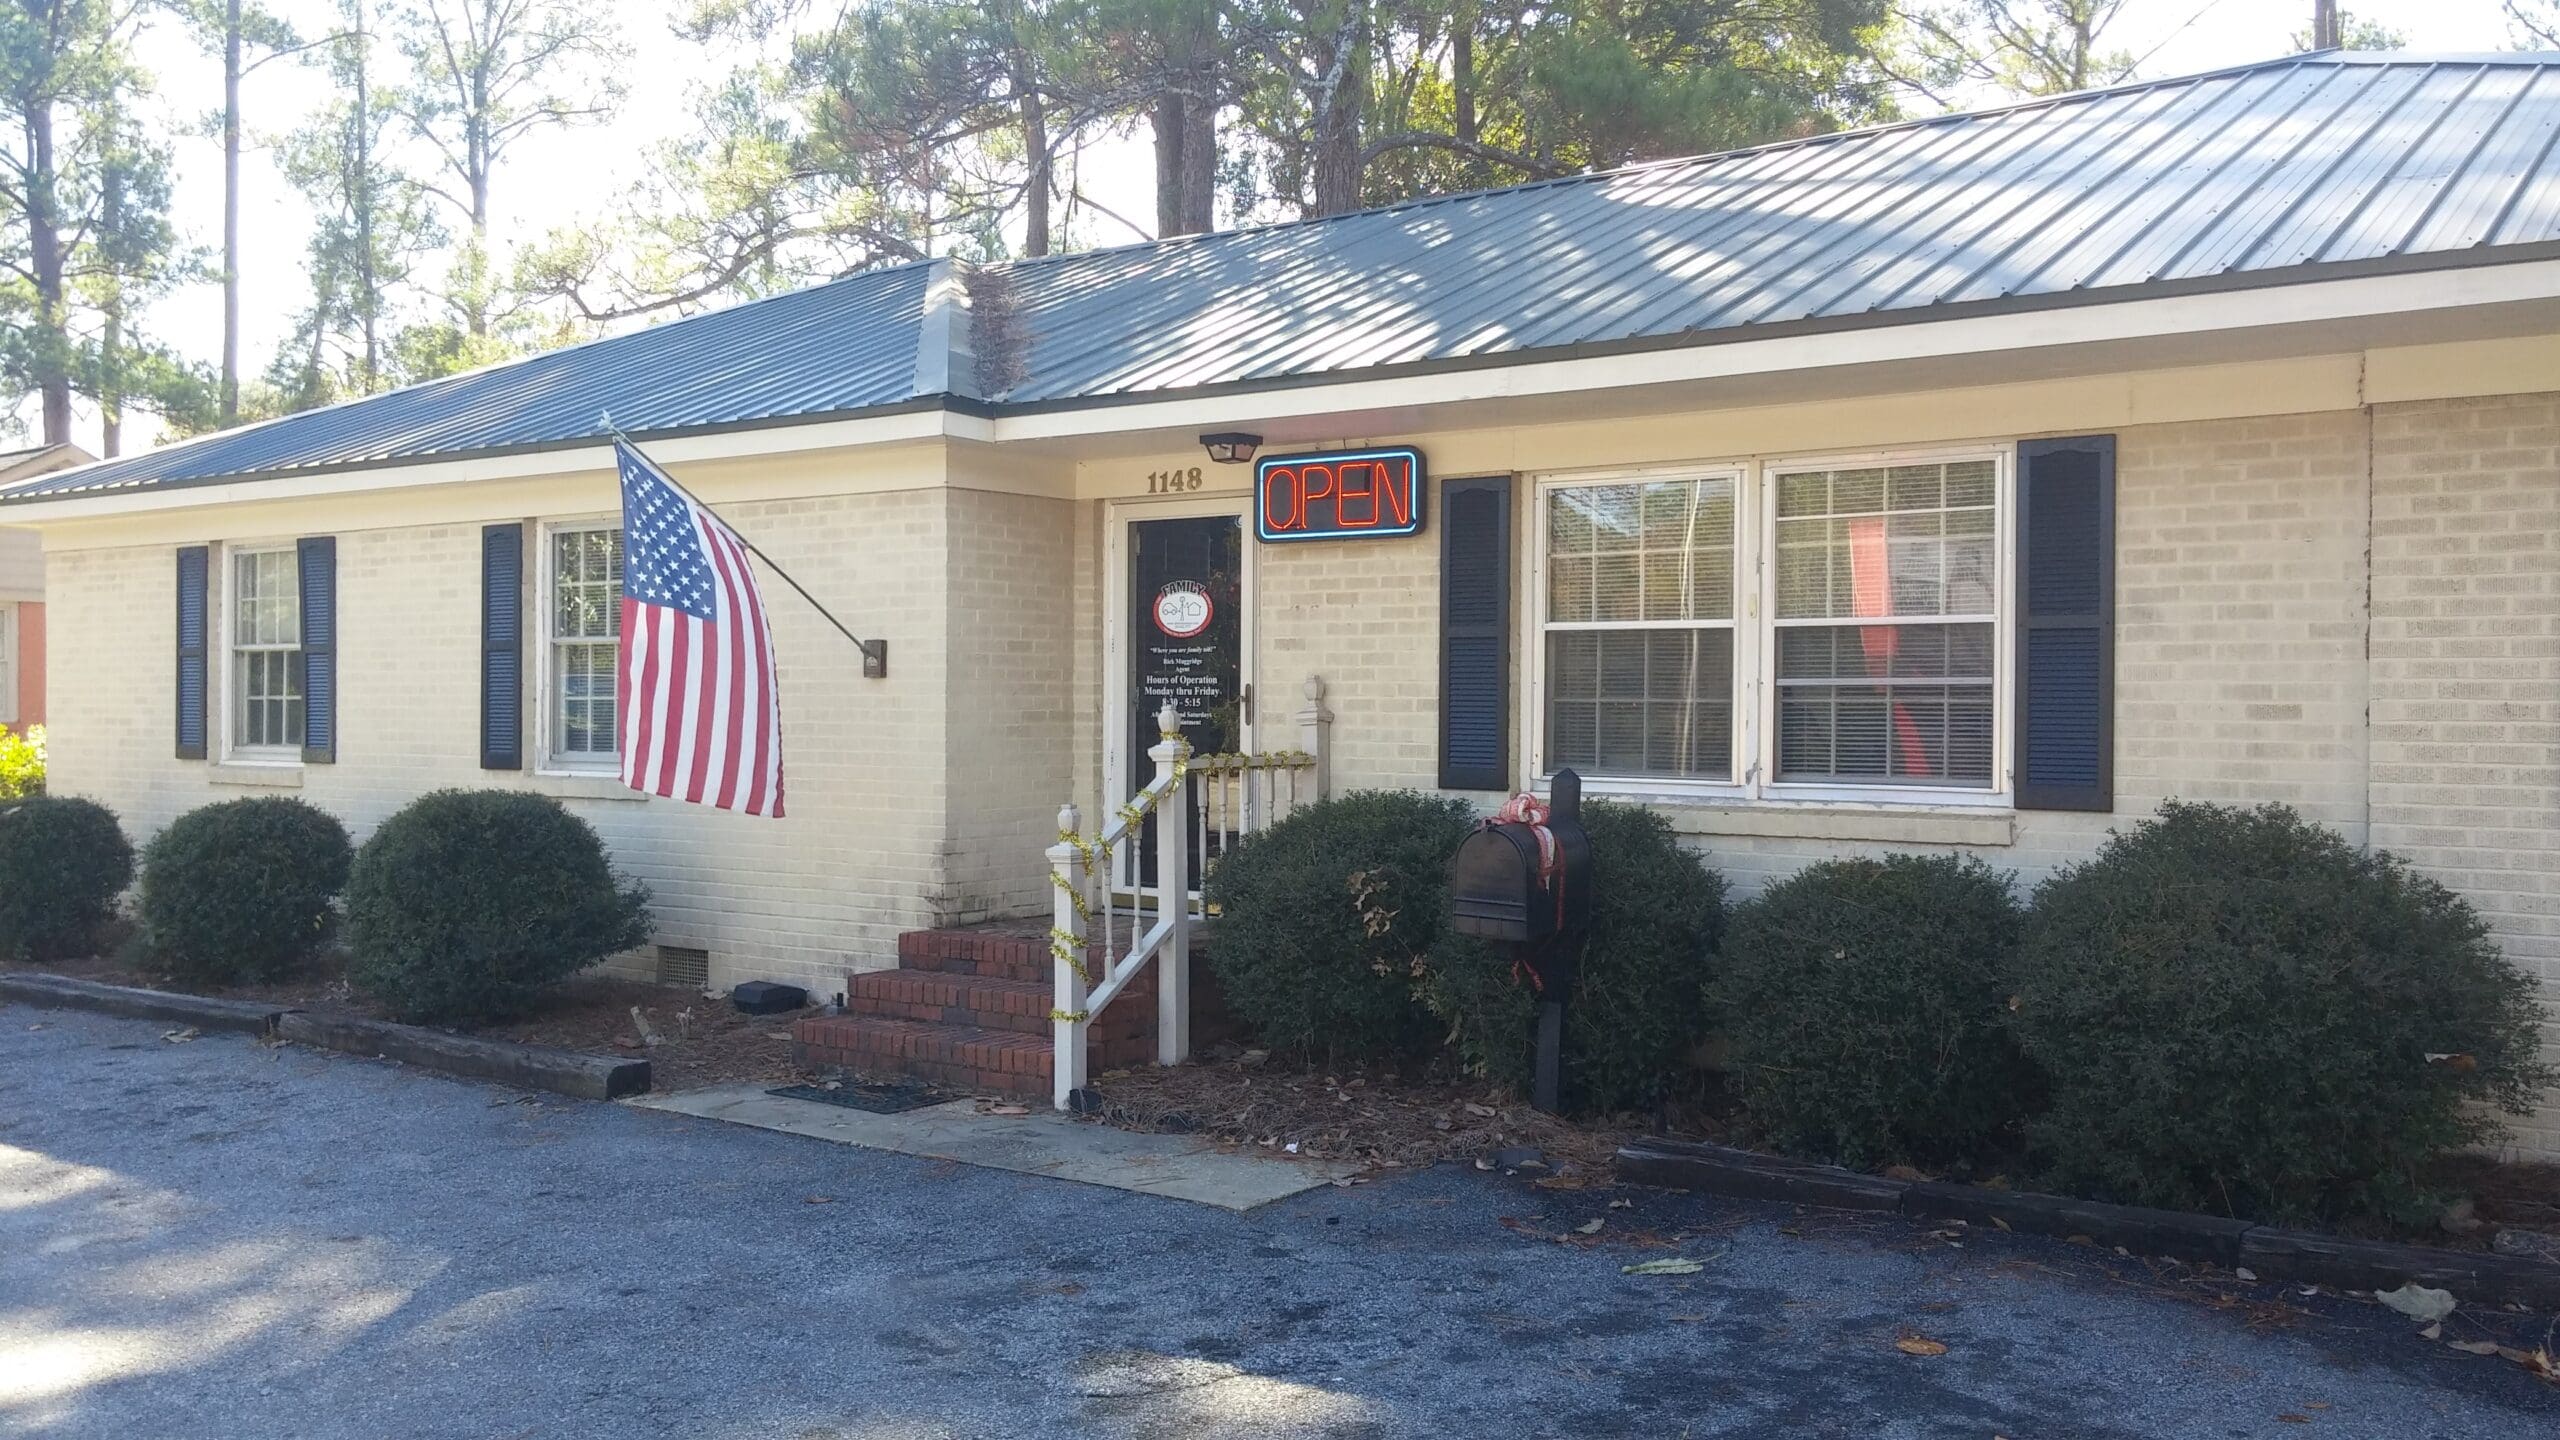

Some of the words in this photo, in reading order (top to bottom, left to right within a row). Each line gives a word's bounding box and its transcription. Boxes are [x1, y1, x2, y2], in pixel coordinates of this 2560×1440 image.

[1147, 467, 1203, 494] 1148
[1265, 460, 1411, 530] OPEN
[1160, 579, 1206, 598] FAMILY
[1146, 675, 1169, 685] Hours
[1170, 675, 1179, 684] of
[1180, 675, 1217, 686] Operation
[1144, 687, 1174, 697] Monday
[1176, 686, 1193, 696] thru
[1162, 697, 1178, 707] 8:30
[1184, 697, 1201, 707] 5:15
